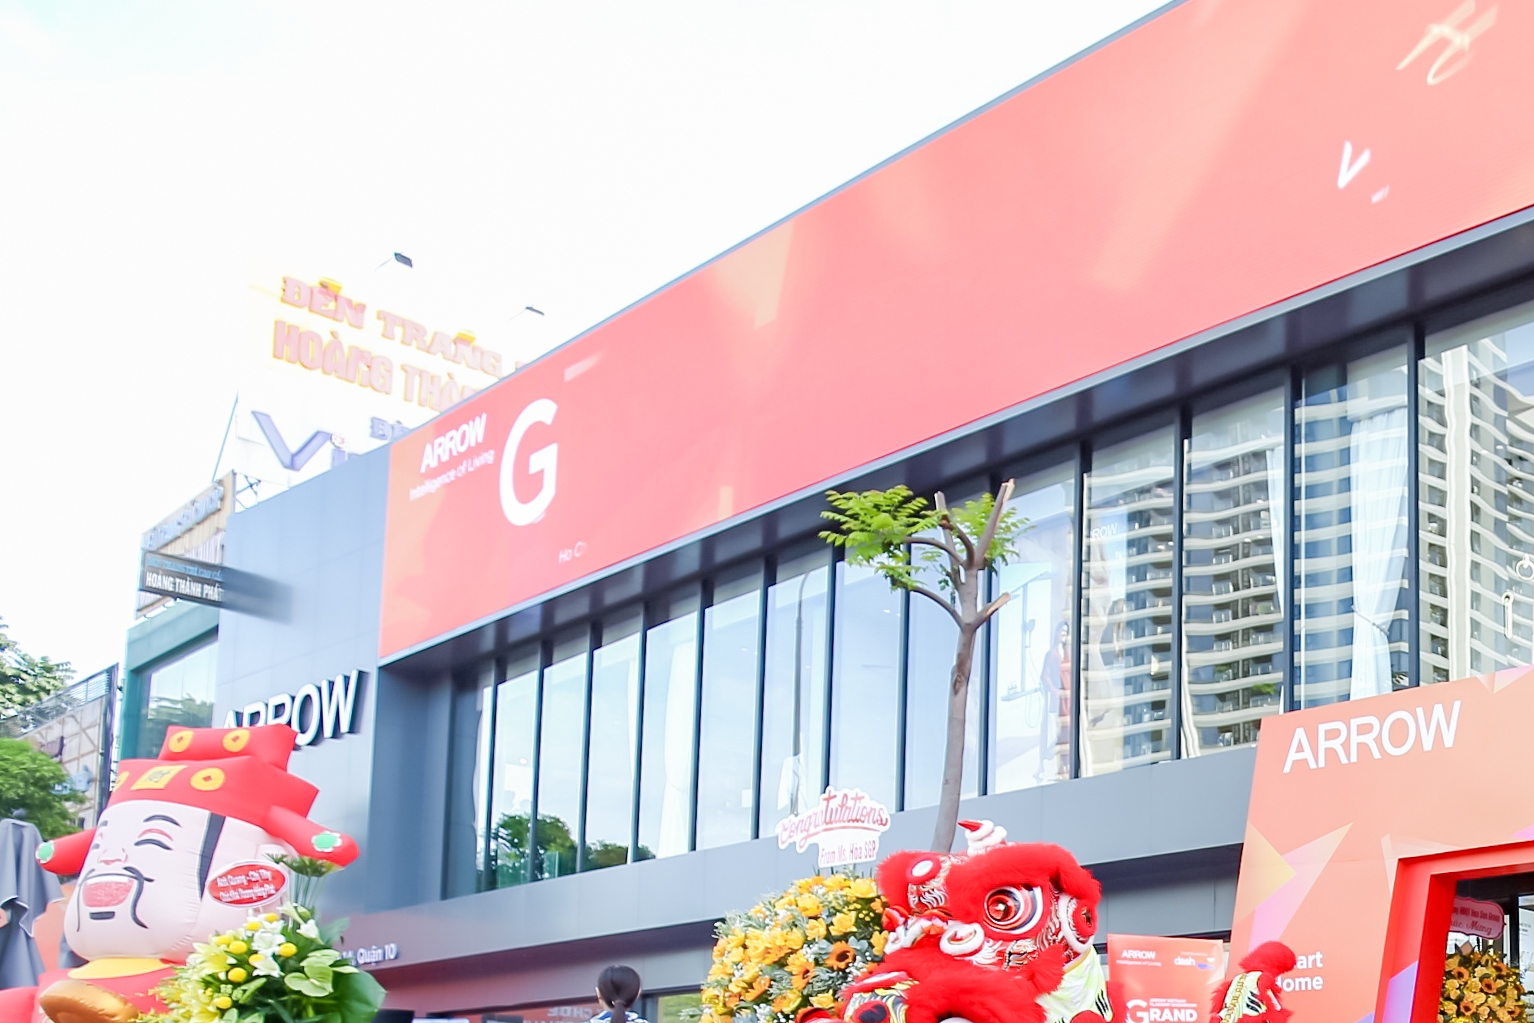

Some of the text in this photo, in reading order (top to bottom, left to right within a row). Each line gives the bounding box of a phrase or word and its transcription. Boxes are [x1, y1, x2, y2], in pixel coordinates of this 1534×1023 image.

[376, 310, 503, 378] TRANG
[272, 320, 478, 413] HOÀNG THÀ
[419, 411, 488, 474] ARROW
[408, 468, 457, 501] Intelligence
[466, 449, 496, 473] Living
[1089, 522, 1118, 540] ROW
[145, 570, 175, 592] HOÀNG
[175, 576, 202, 598] THÀNH
[1283, 700, 1461, 774] ARROW
[778, 789, 889, 849] Congratulations
[820, 847, 836, 865] From
[357, 944, 384, 967] Quận
[384, 943, 398, 960] 10
[1121, 949, 1156, 960] ARROW
[1173, 956, 1196, 966] dash
[1295, 950, 1324, 970] art
